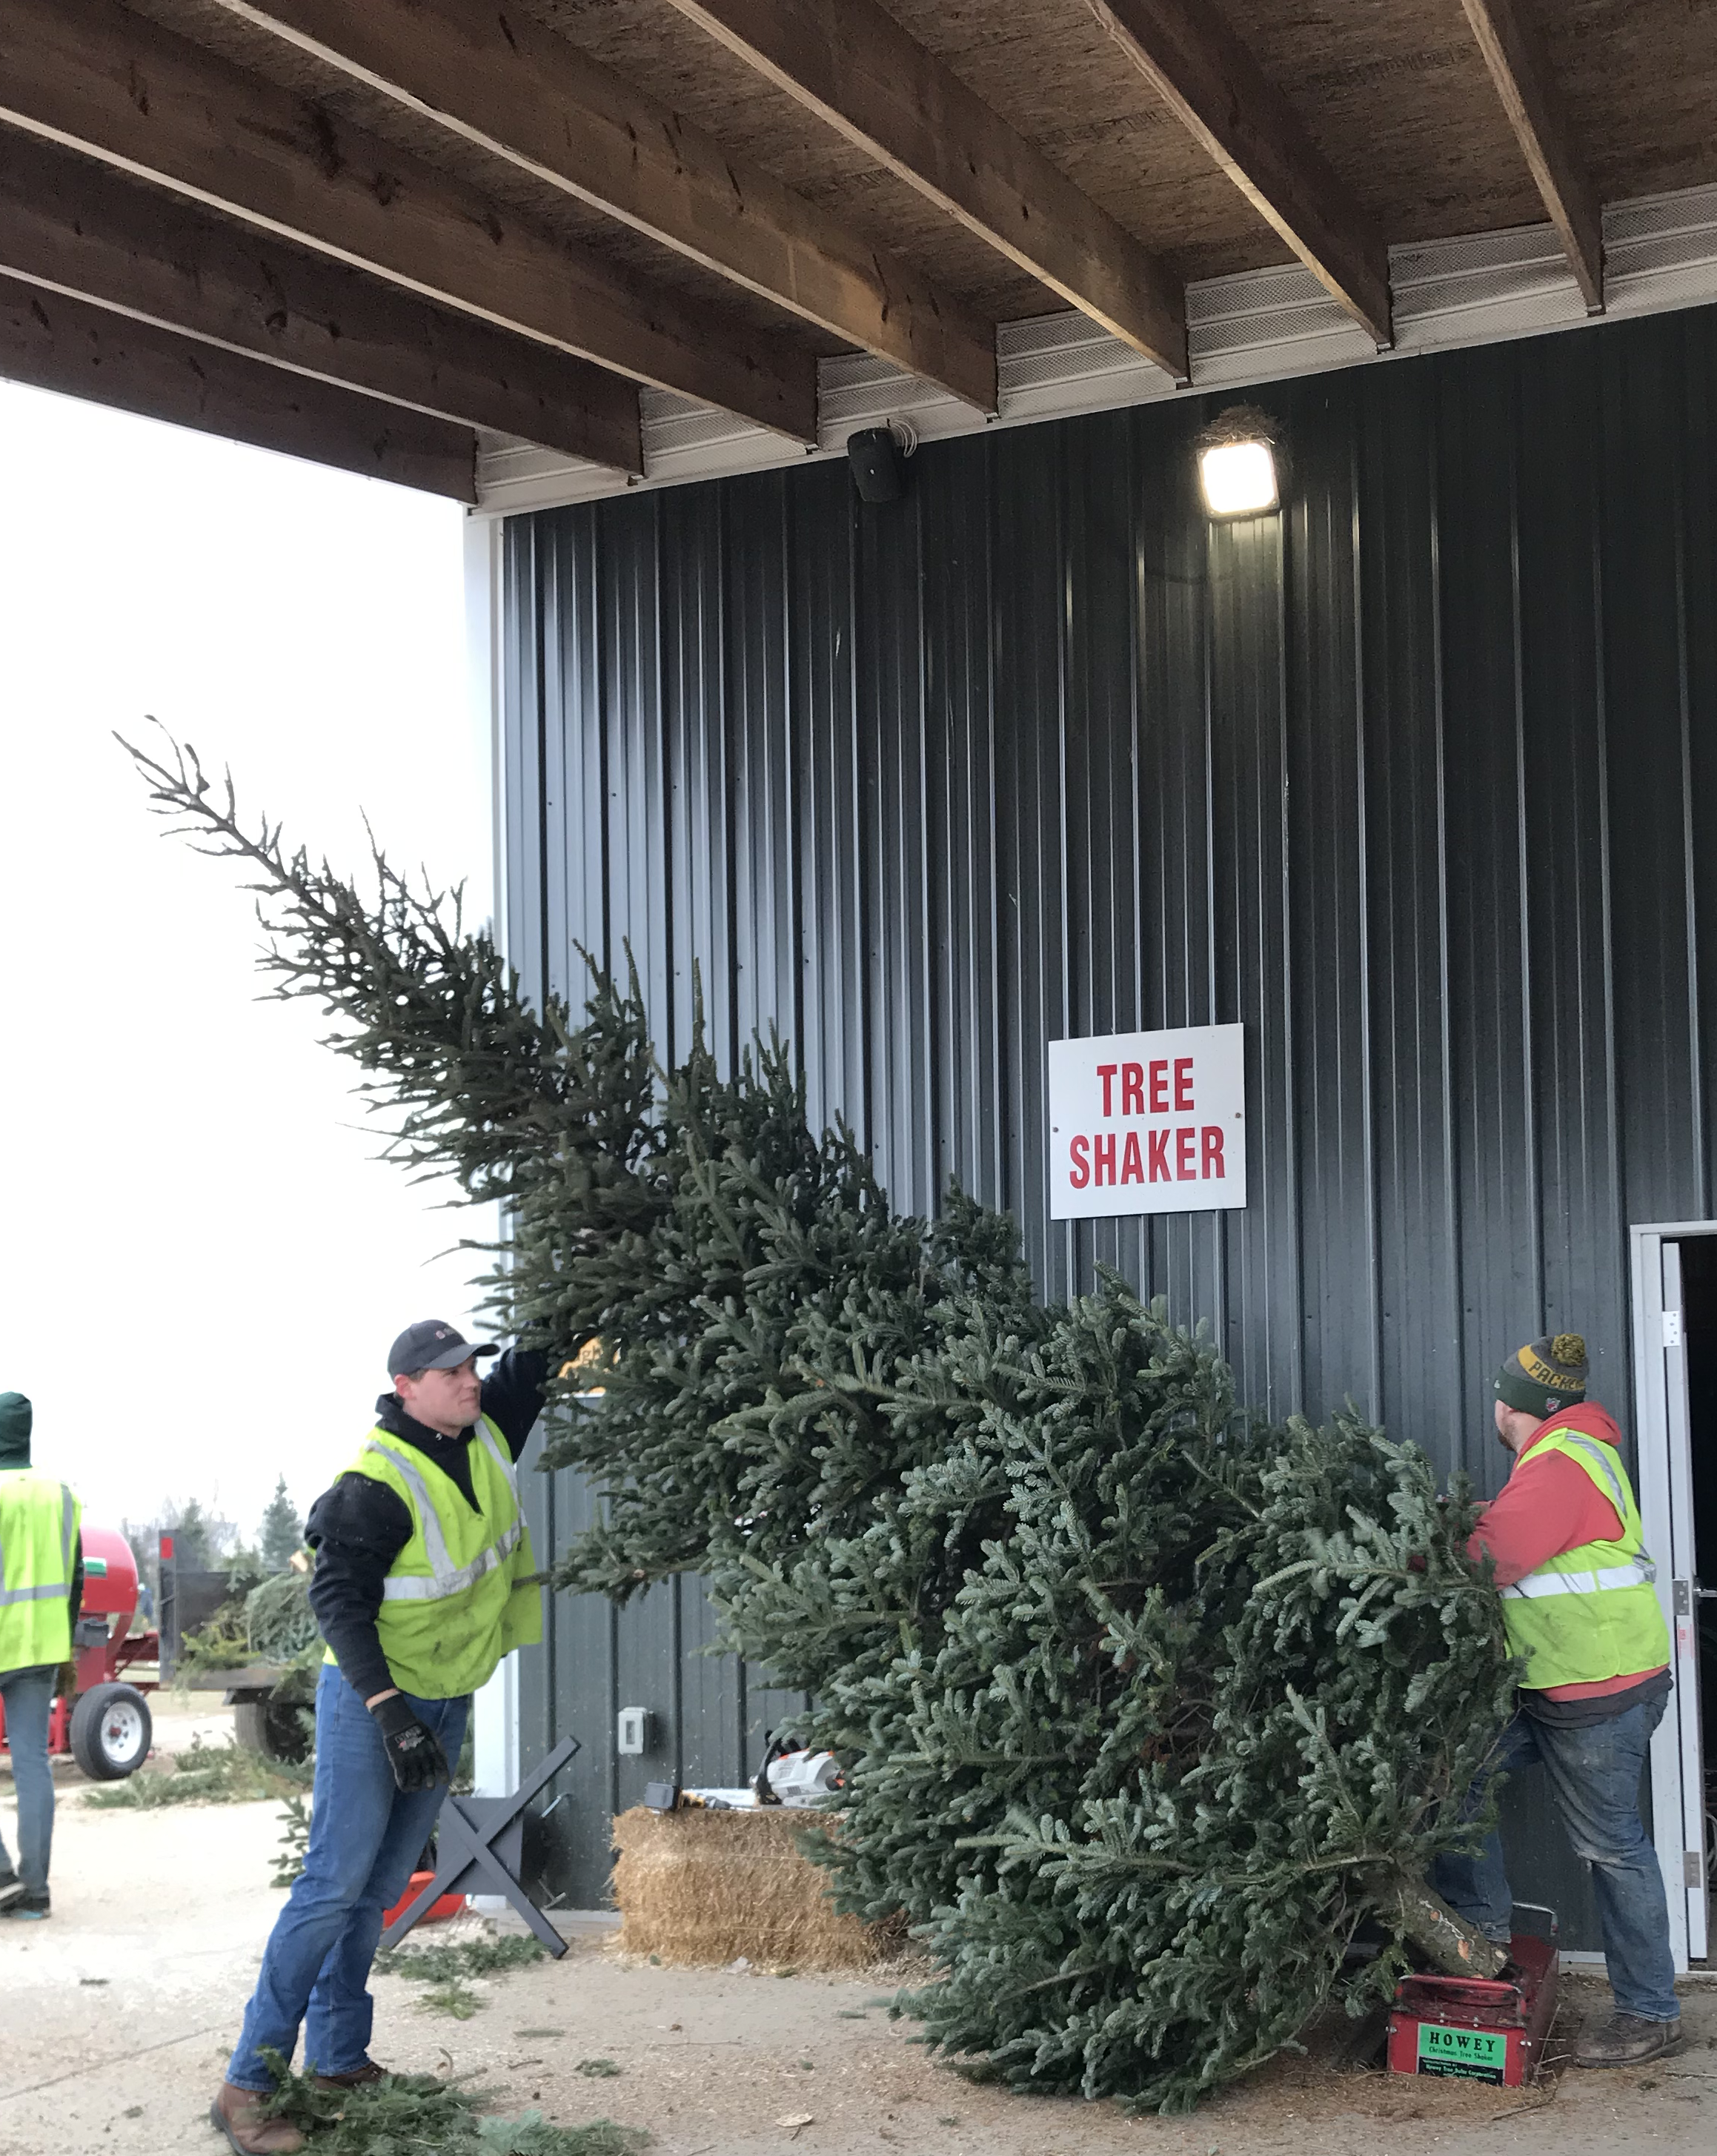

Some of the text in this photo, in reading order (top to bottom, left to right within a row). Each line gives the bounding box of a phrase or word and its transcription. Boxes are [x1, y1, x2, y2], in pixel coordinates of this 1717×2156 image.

[1097, 1058, 1195, 1117] TREE
[1069, 1126, 1226, 1189] SHAKER
[1429, 2031, 1495, 2052] HOWEY
[1429, 2046, 1493, 2061] Christmas Tree Shaker
